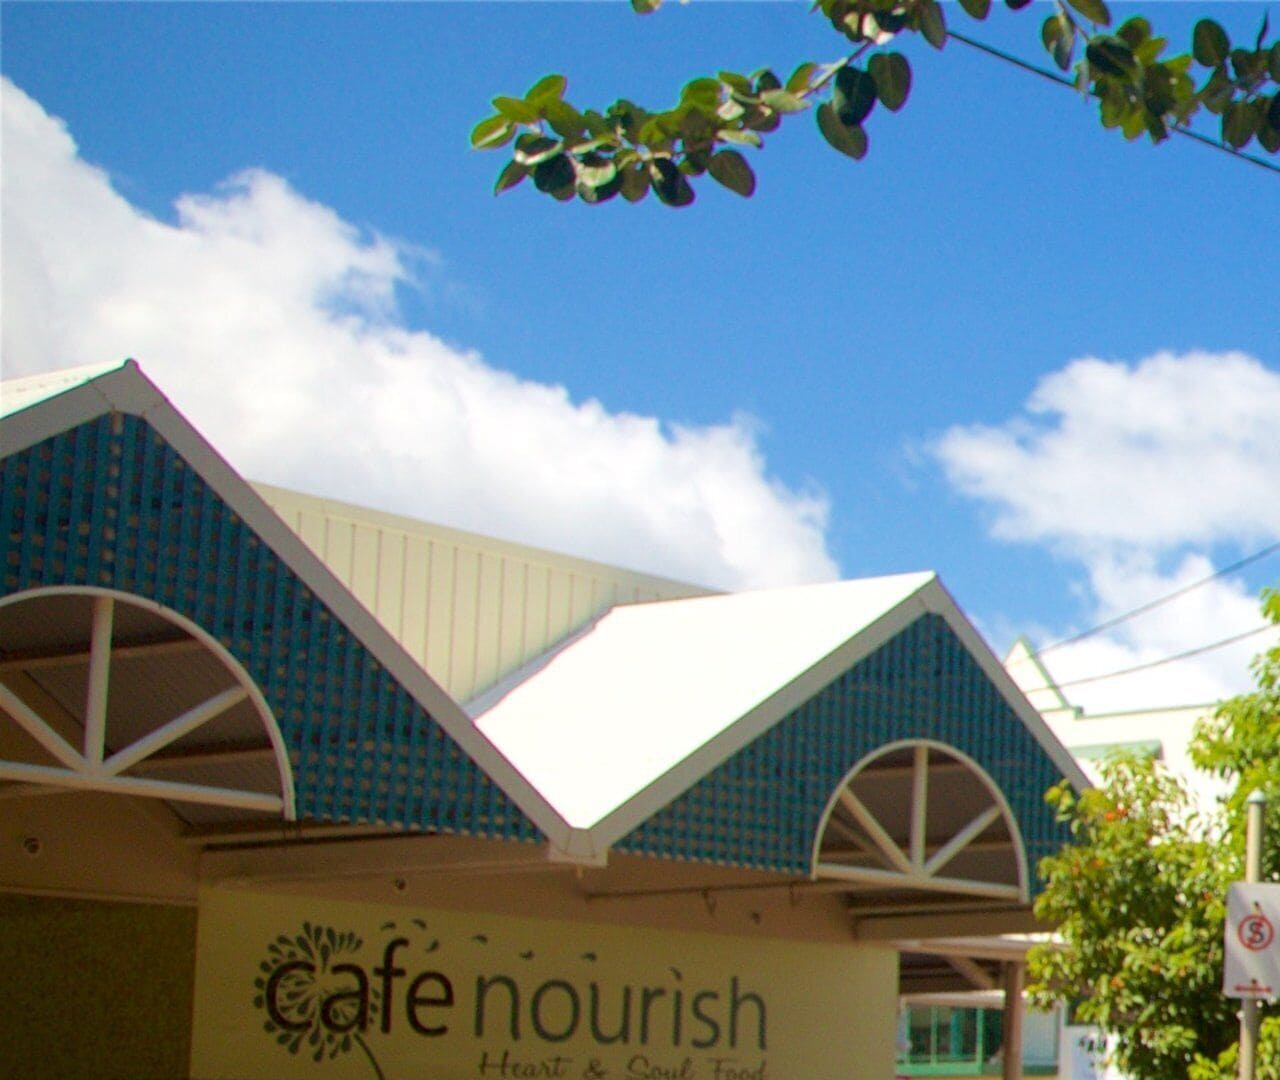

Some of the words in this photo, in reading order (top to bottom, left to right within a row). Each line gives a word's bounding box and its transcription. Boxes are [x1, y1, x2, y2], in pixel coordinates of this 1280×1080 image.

[475, 966, 768, 1050] nourish
[477, 1050, 573, 1079] Heart
[582, 1059, 609, 1080] &
